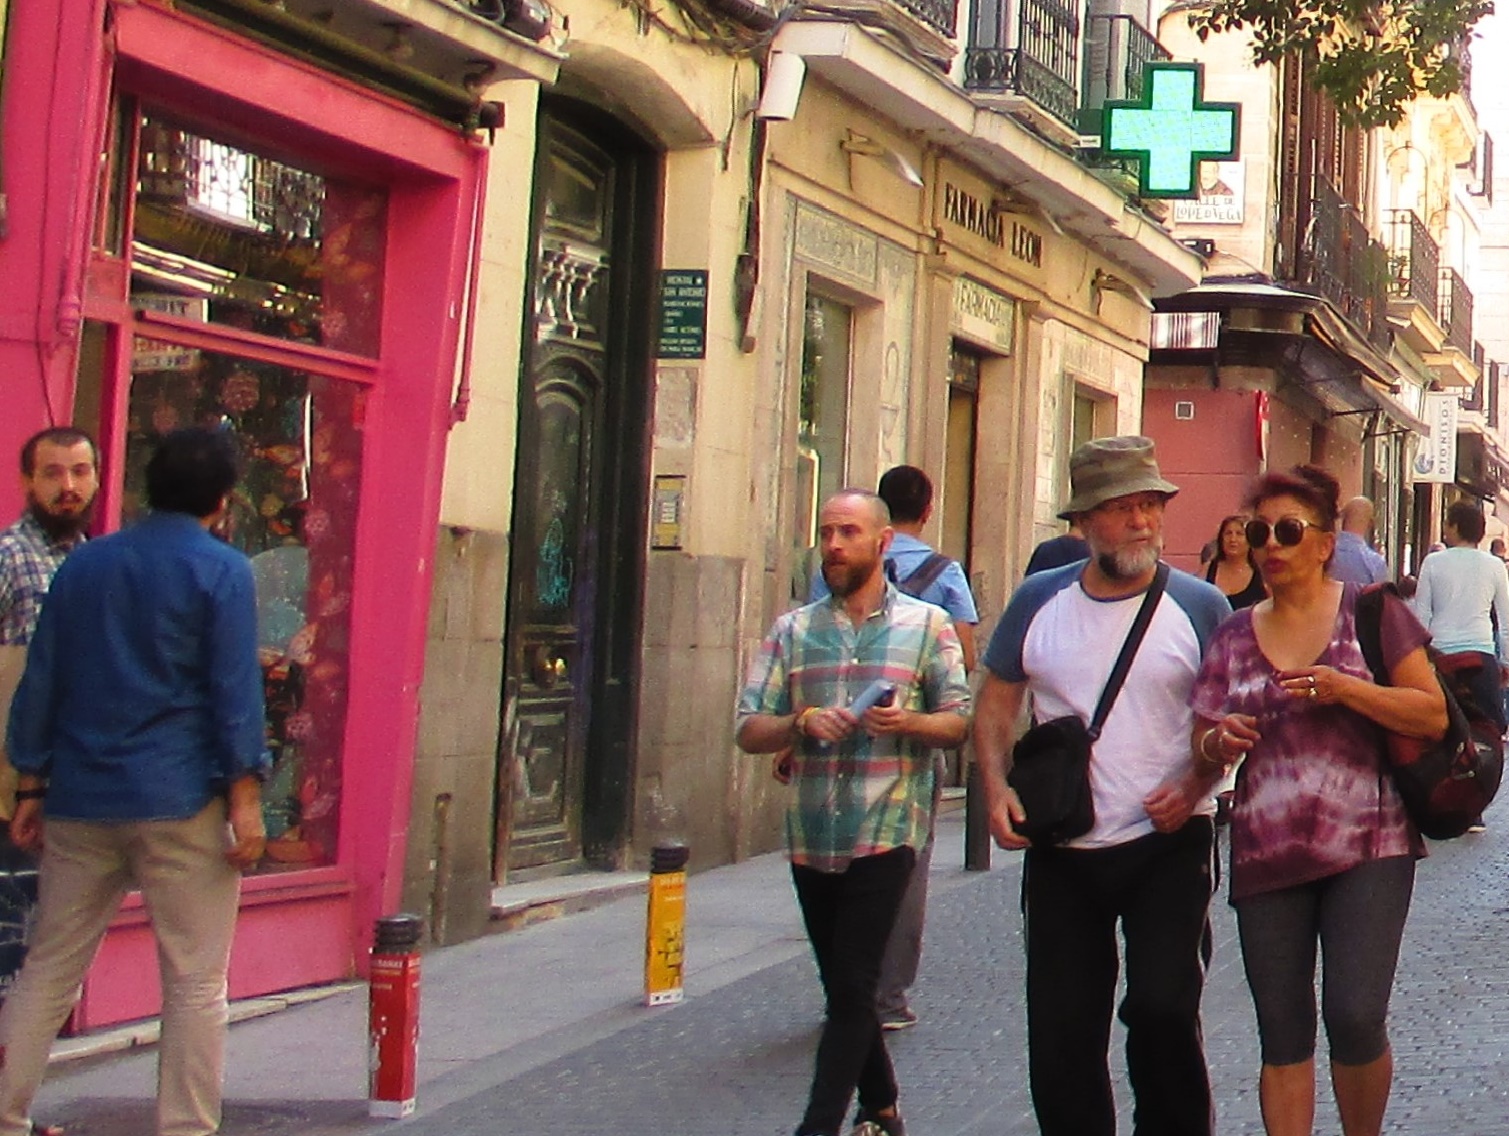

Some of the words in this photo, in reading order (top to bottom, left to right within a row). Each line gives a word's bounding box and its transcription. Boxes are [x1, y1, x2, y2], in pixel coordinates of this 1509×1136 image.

[944, 181, 1004, 249] FARMACIA
[1010, 221, 1043, 269] LEON
[1439, 399, 1448, 475] DIONISOS
